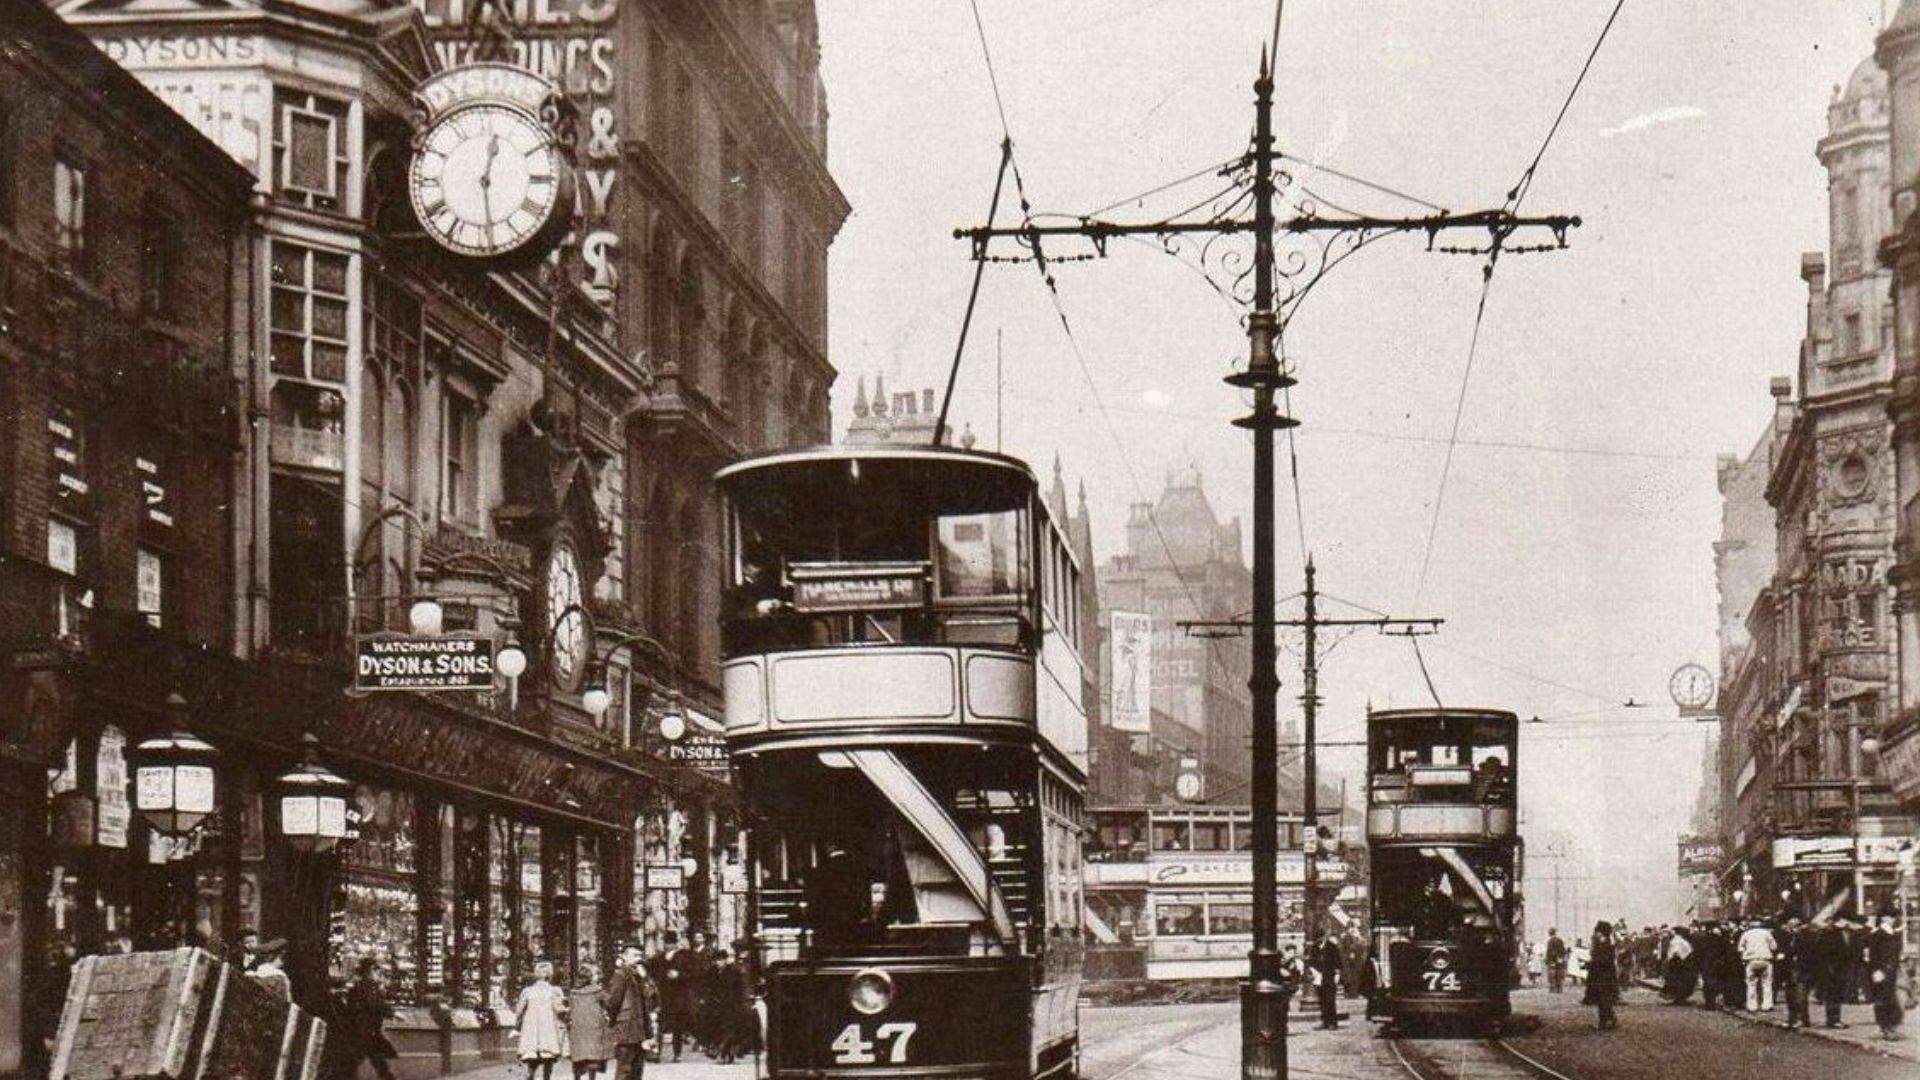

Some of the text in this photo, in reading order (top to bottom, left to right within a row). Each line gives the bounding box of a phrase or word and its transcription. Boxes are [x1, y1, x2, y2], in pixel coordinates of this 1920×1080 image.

[105, 34, 255, 63] DYSONS
[372, 641, 476, 652] WATCHMAKERS
[359, 654, 420, 676] DYSON
[421, 658, 434, 675] &
[1422, 971, 1461, 990] 74
[831, 1023, 917, 1064] 47
